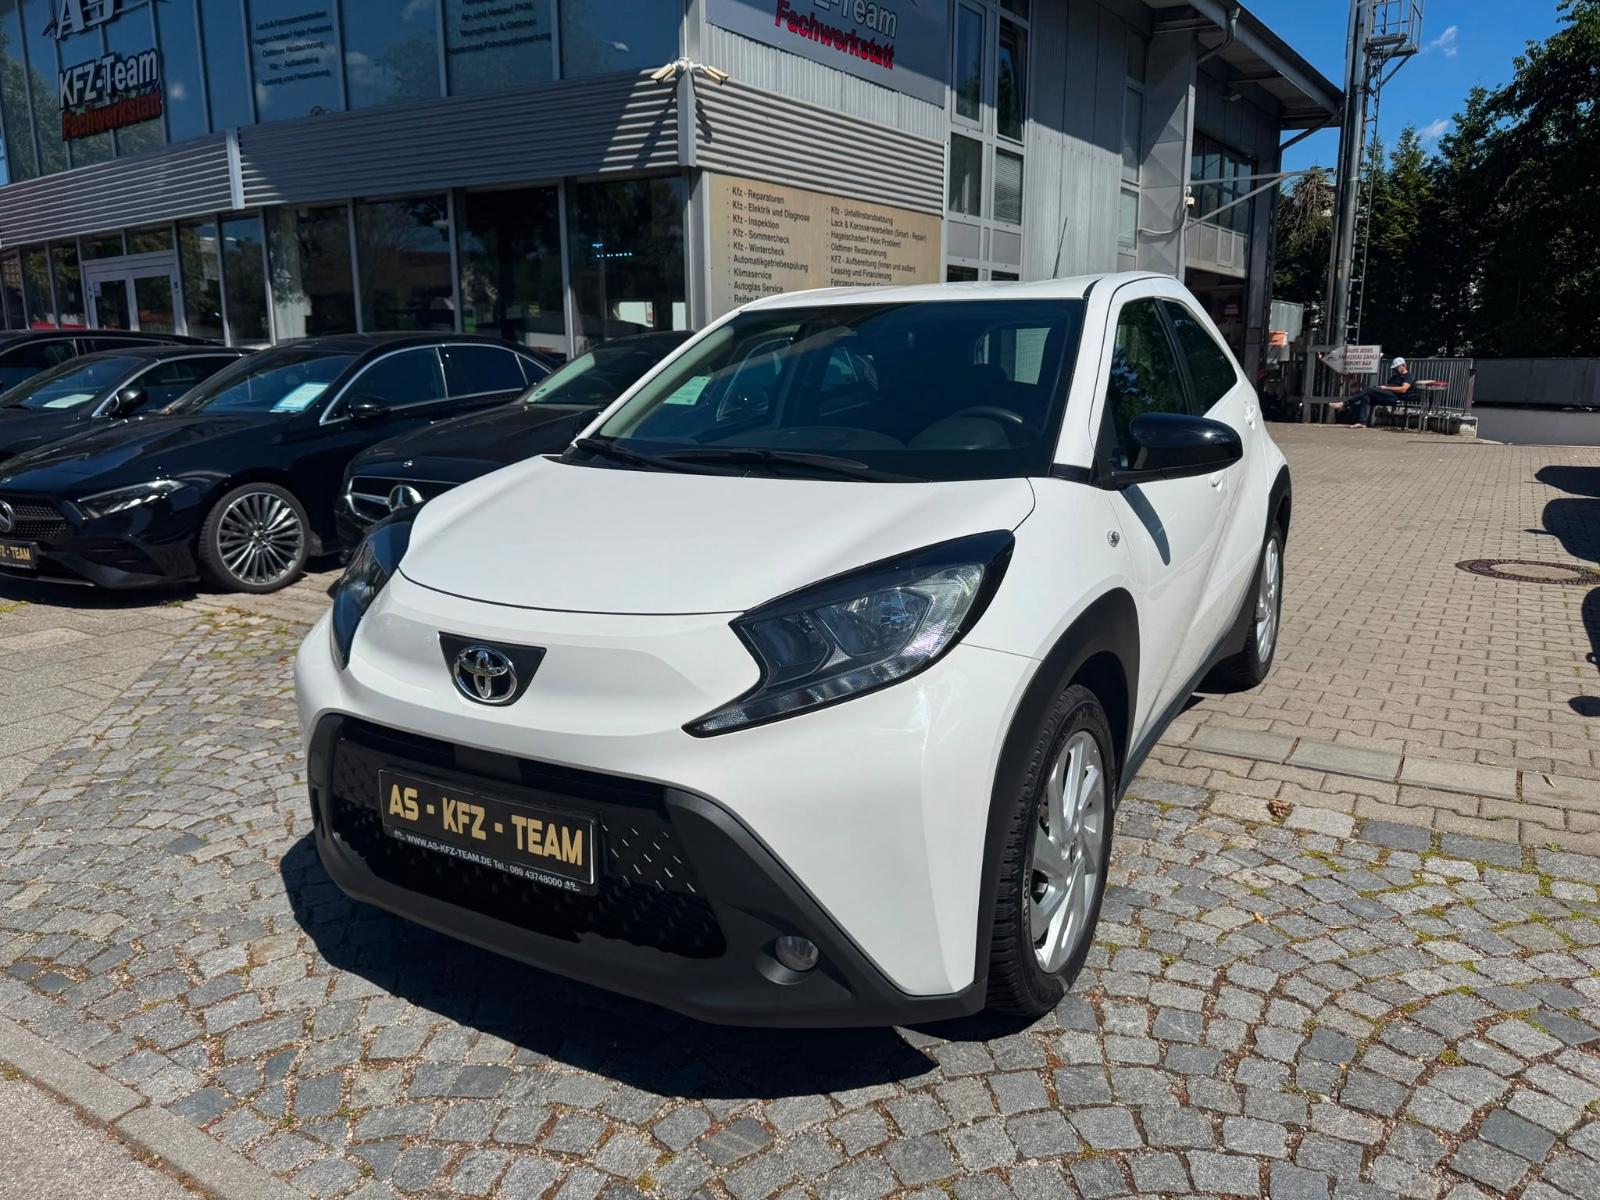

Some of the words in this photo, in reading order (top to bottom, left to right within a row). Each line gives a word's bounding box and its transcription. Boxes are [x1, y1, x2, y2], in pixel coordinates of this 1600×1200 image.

[774, 0, 896, 70] Fachwerkstatt
[60, 48, 159, 109] KFZ-Team
[748, 189, 784, 204] Reparaturen
[748, 203, 771, 215] Elektrik
[772, 209, 783, 217] und
[784, 210, 810, 222] Diagnose
[748, 216, 779, 229] Inspektion
[831, 218, 843, 228] Lack
[748, 230, 790, 244] Sommercheck
[748, 243, 785, 256] Wintercheck
[733, 267, 772, 280] Klimaservice
[831, 266, 851, 277] Leasing
[852, 269, 862, 277] und
[734, 281, 760, 293] Autoglas
[761, 282, 783, 293] Service
[10, 546, 32, 560] TEAM
[389, 784, 419, 821] AS
[442, 797, 487, 841] KFZ
[511, 814, 583, 866] TEAM
